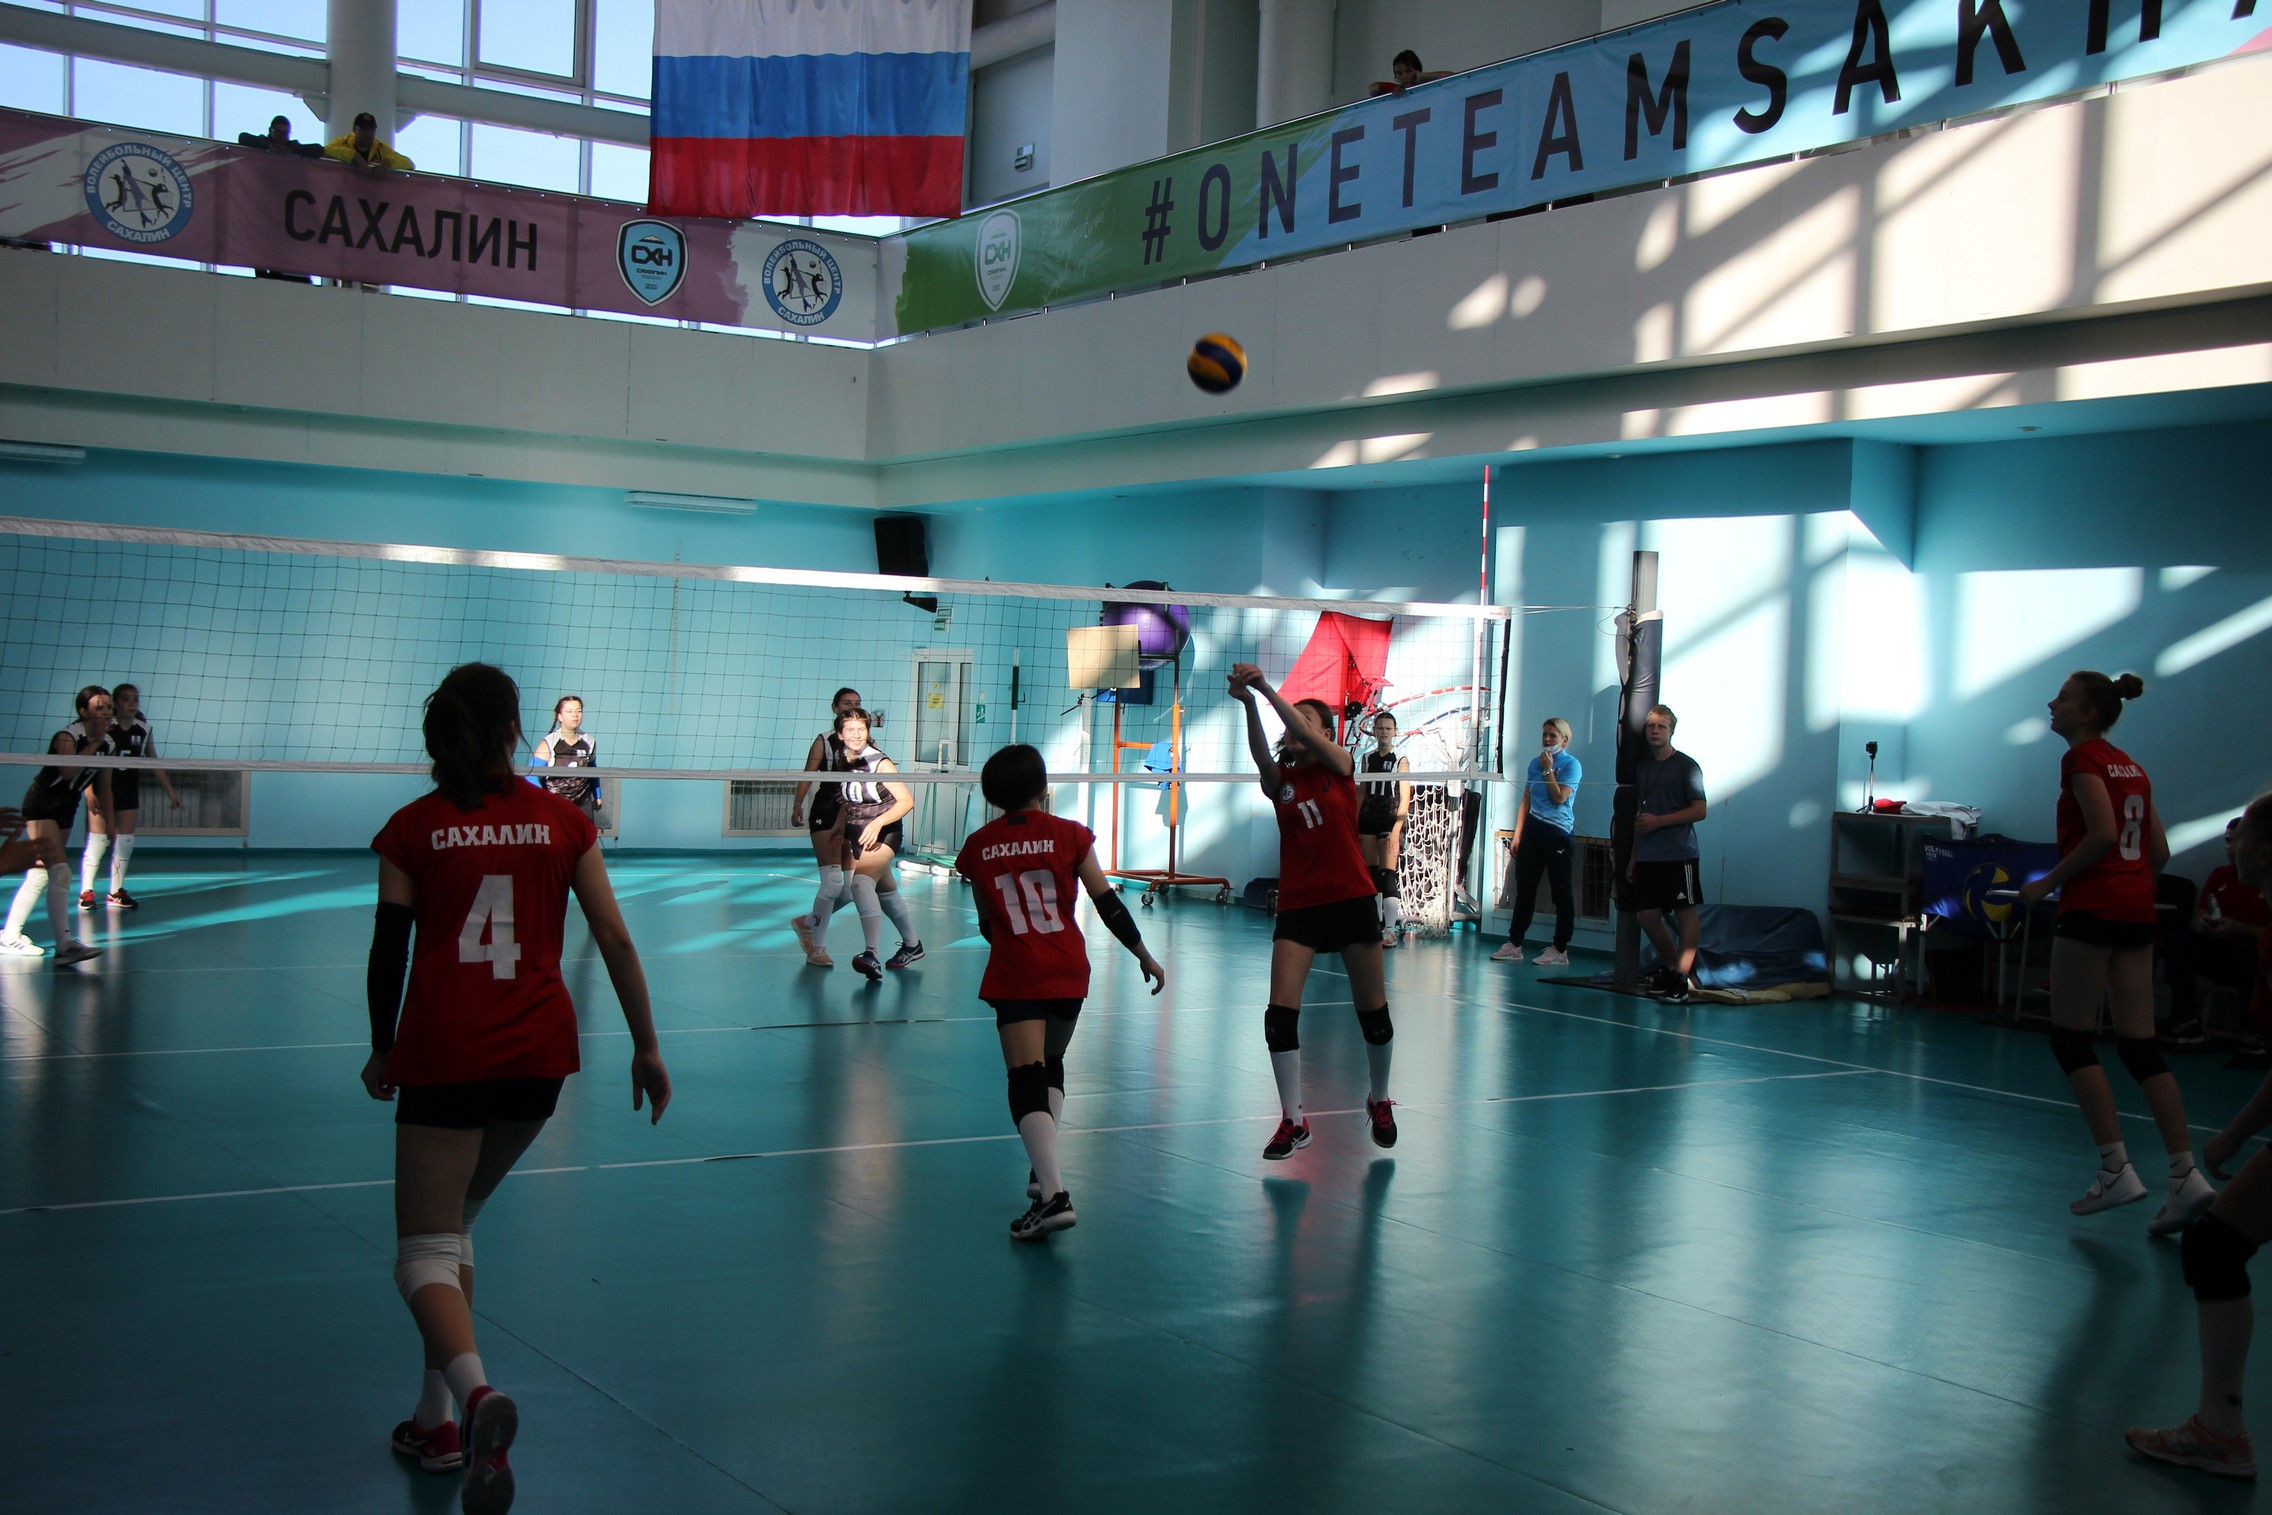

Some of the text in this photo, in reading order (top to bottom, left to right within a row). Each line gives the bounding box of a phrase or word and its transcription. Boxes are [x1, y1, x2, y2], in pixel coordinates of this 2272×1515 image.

[1142, 0, 2259, 265] #ONETEAMSAK
[171, 166, 193, 208] ЦЕНТР
[107, 221, 171, 242] САХАЛИН
[284, 189, 538, 271] САХАЛИН
[826, 258, 841, 294] ЦЕНТР
[778, 306, 825, 324] САХАЛИН
[1297, 798, 1323, 829] 11
[2120, 794, 2144, 861] 8
[431, 823, 551, 850] САХАЛИН
[982, 839, 1054, 861] САХАЛИН
[994, 869, 1065, 935] 10
[459, 874, 521, 979] 4
